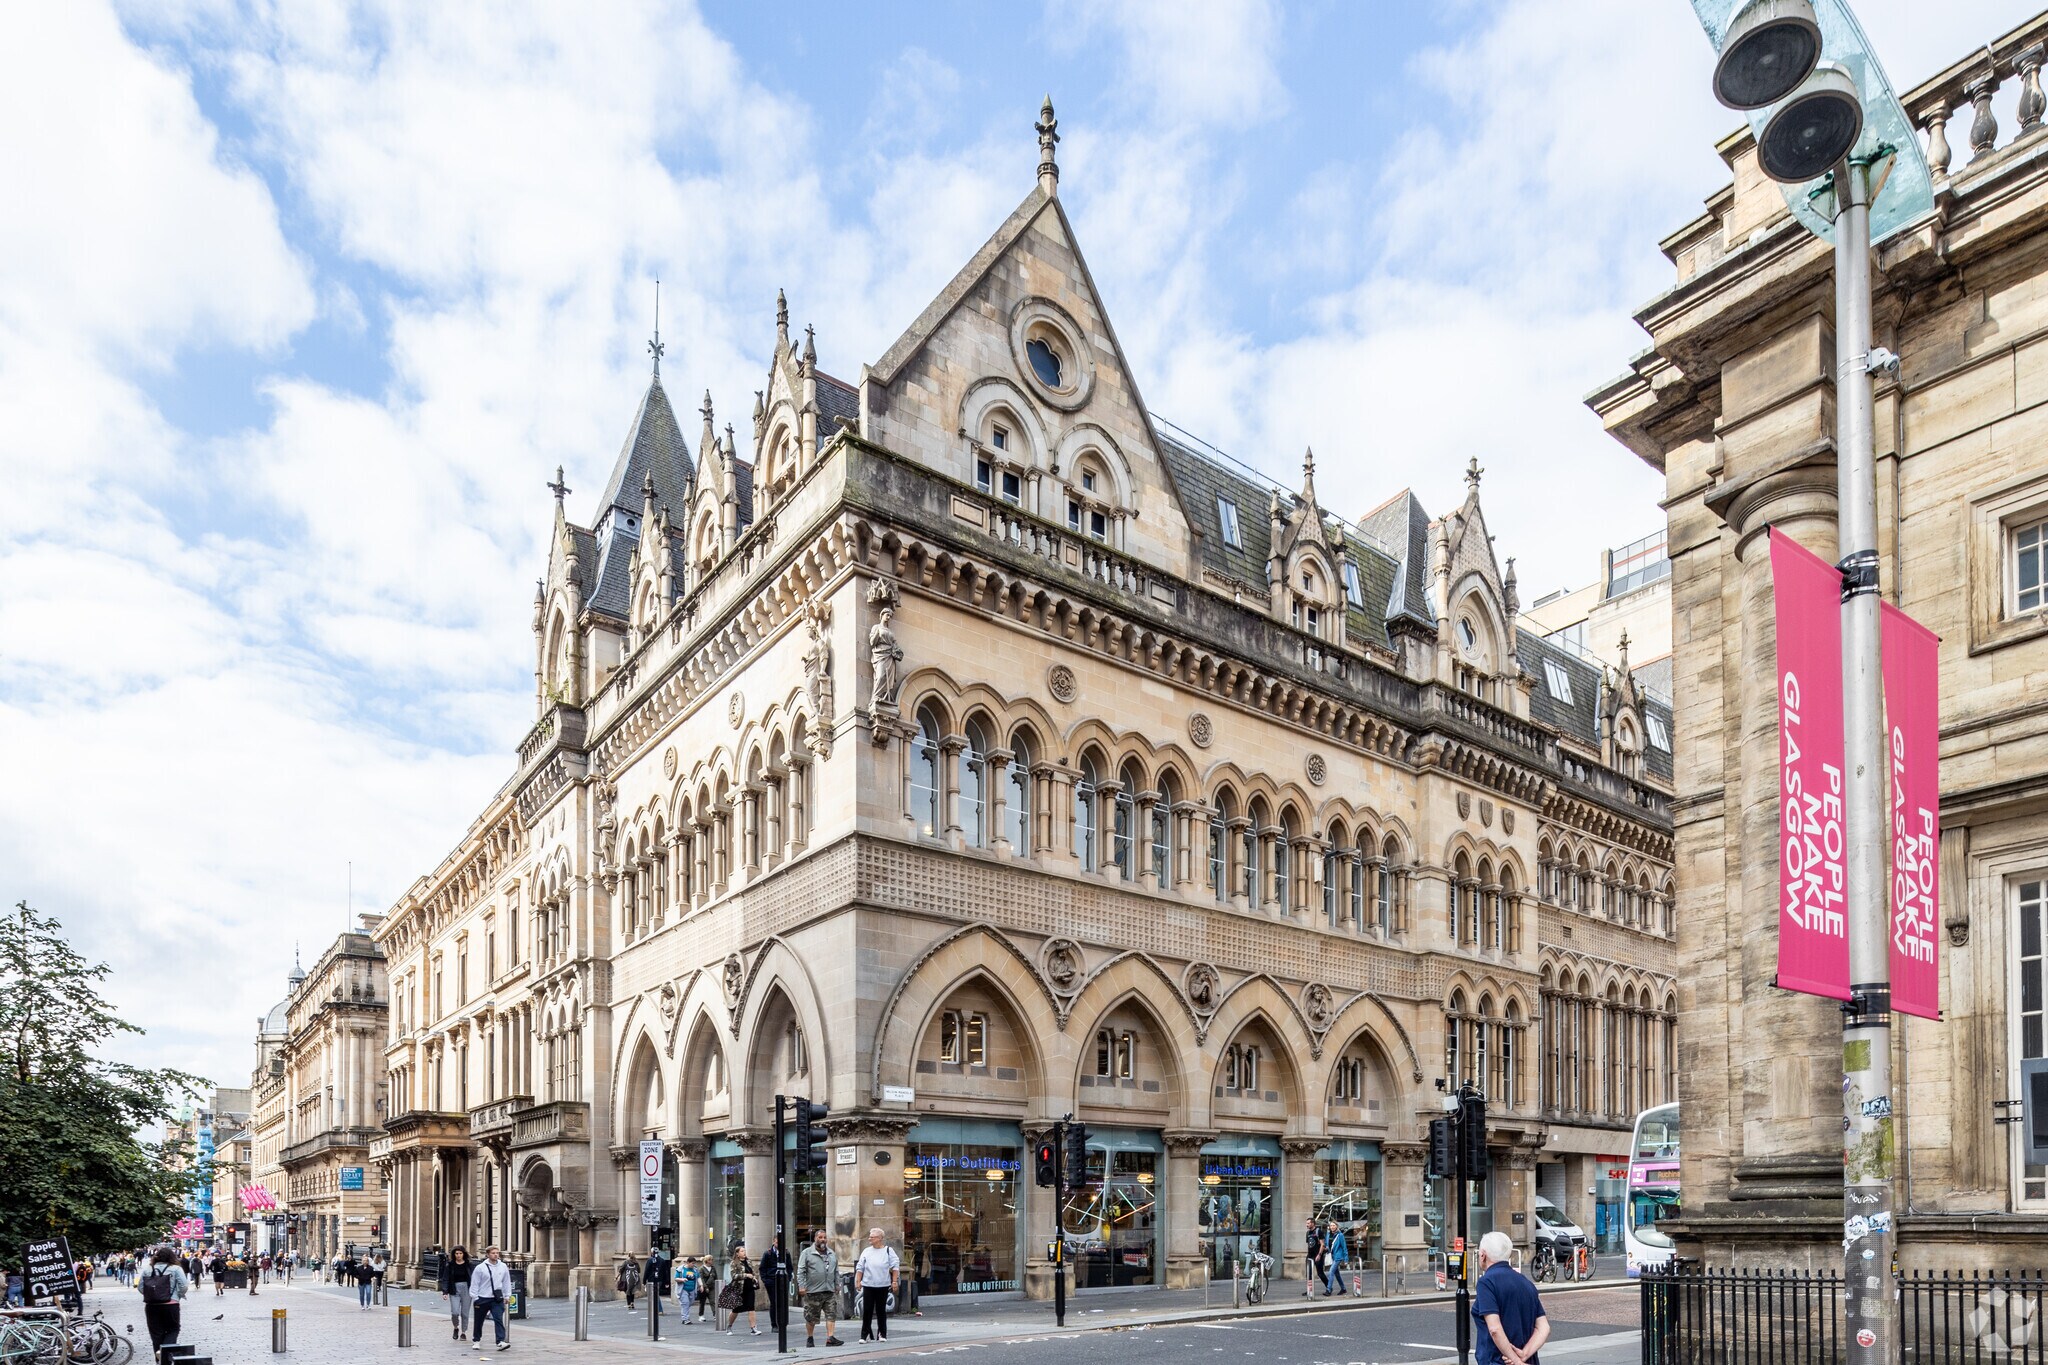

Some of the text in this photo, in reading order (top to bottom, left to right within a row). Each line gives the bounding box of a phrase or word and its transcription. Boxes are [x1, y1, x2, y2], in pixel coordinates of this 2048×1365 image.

[1783, 671, 1803, 928] GLASGOW
[1803, 792, 1824, 934] MAKE
[1823, 763, 1844, 938] PEOPLE
[1893, 726, 1906, 956] GLASGOW
[1905, 834, 1919, 961] MAKE
[1918, 807, 1934, 965] PEOPLE
[917, 1155, 1021, 1171] Urban Outfitters
[1205, 1163, 1279, 1177] Urban Outfitters
[28, 1253, 53, 1263] Sales
[29, 1241, 57, 1252] Apple
[31, 1262, 67, 1274] Repairs
[957, 1279, 1020, 1292] URBAN OUTFITTERS
